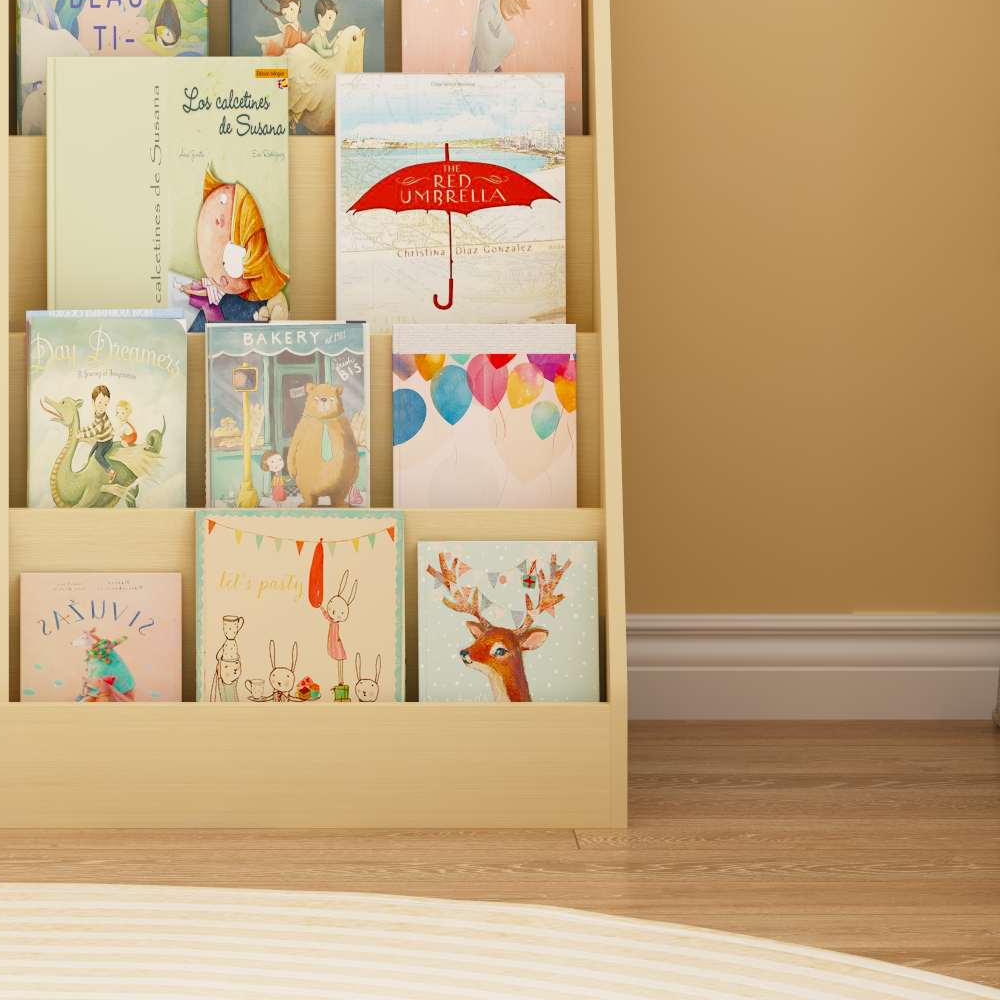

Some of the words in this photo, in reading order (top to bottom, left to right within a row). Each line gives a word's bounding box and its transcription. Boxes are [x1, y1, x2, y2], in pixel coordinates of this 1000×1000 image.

[93, 26, 135, 50] TI-
[182, 86, 212, 113] Los
[215, 89, 271, 110] calcetines
[150, 85, 162, 166] Susana
[219, 115, 233, 135] de
[236, 113, 286, 136] Susana
[443, 164, 460, 172] THE
[150, 172, 161, 197] de
[434, 174, 472, 188] RED
[401, 188, 507, 206] UMBRELLA
[151, 203, 162, 303] calcetines
[397, 246, 446, 258] Christina
[30, 331, 76, 374] Day
[85, 325, 180, 376] Dreamers
[243, 331, 320, 346] BAKERY
[219, 571, 255, 591] let's
[258, 573, 304, 602] party
